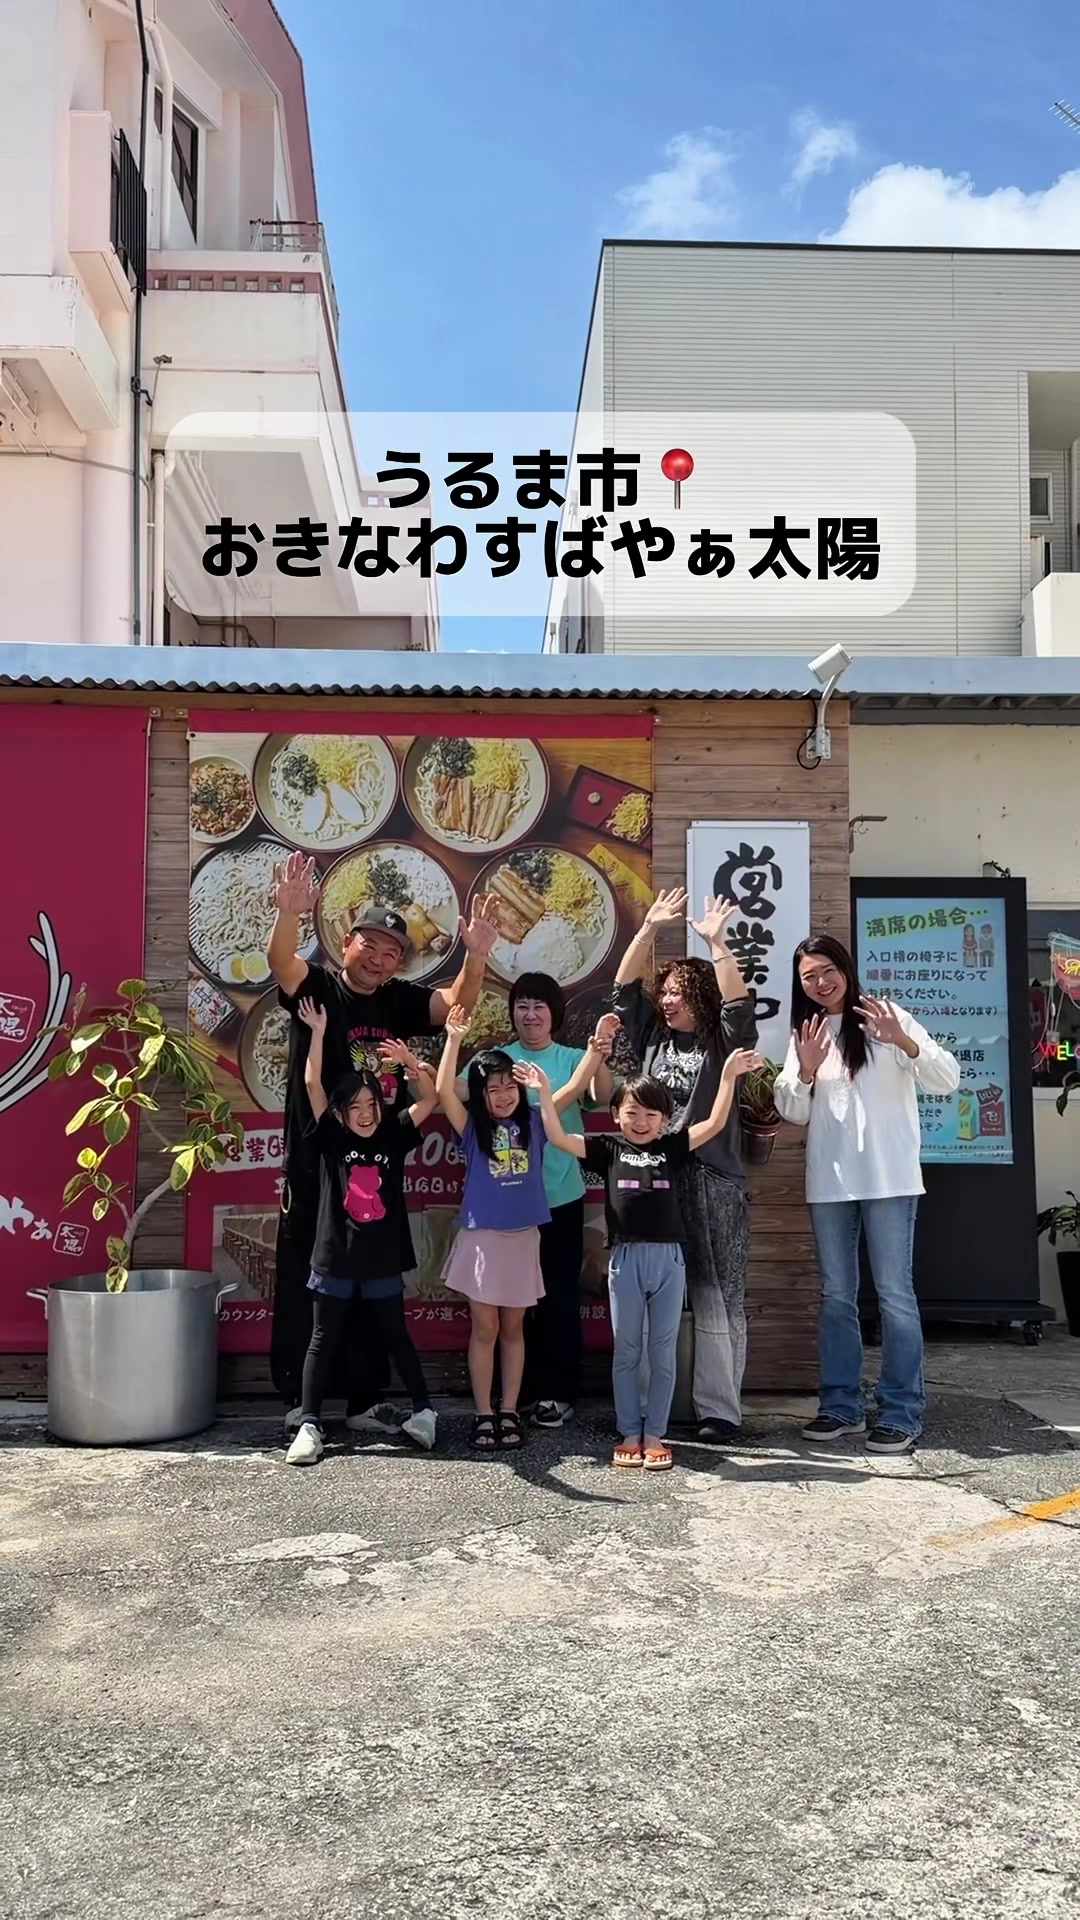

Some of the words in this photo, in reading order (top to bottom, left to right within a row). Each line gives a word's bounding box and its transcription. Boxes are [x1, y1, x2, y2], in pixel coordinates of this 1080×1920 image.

[866, 950, 958, 963] 入口横の椅子に
[866, 969, 988, 982] 順番にお座りになって
